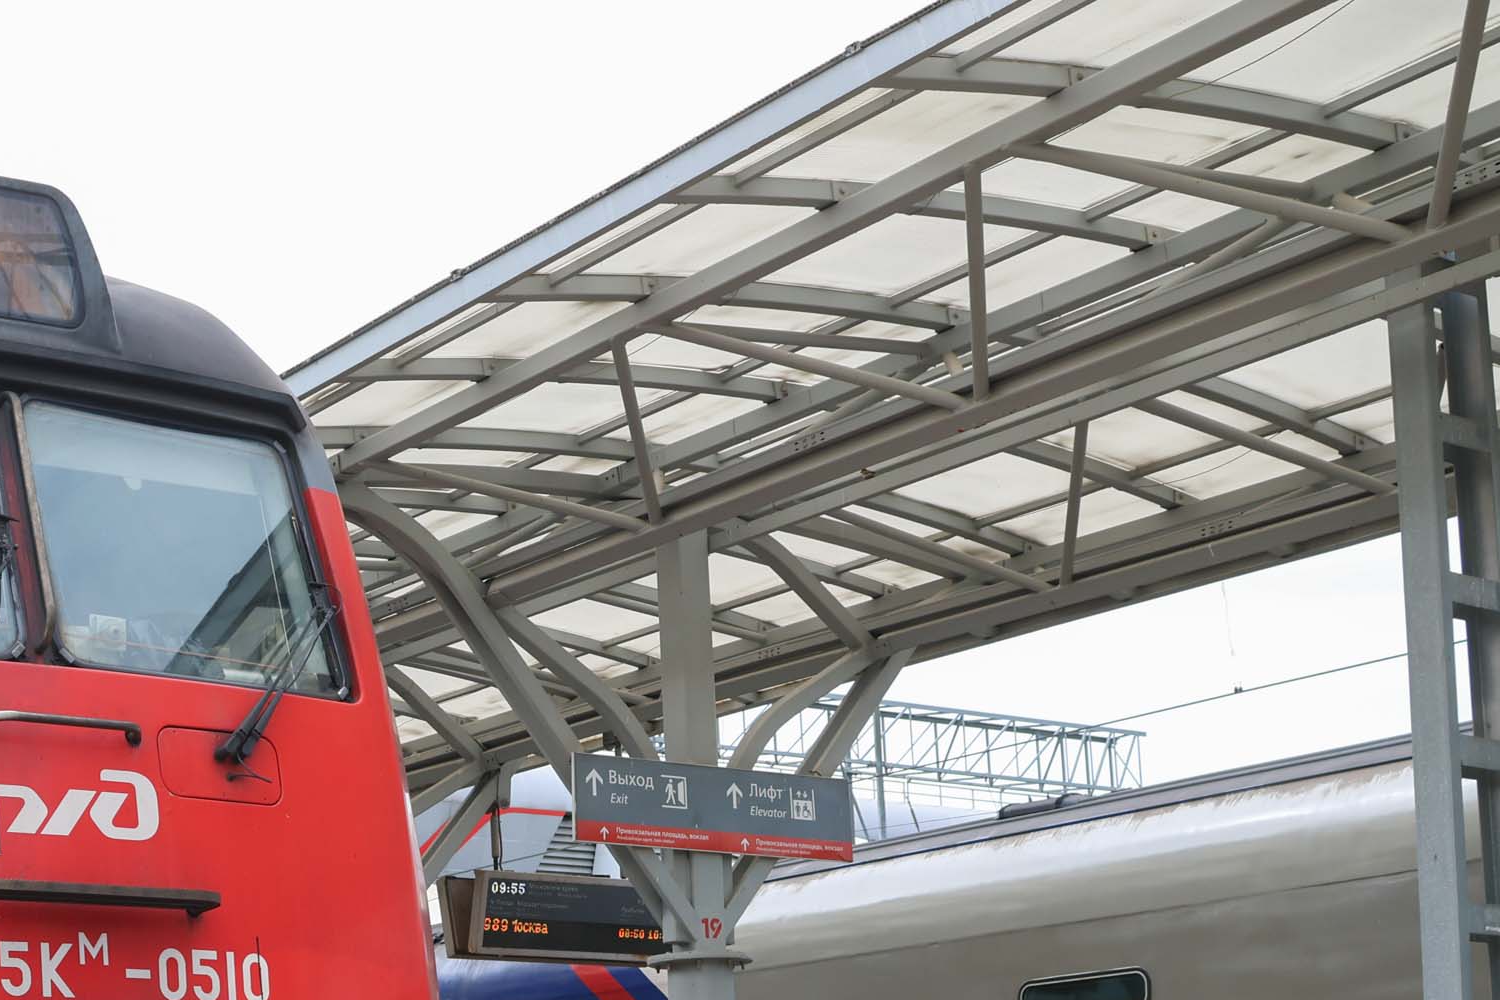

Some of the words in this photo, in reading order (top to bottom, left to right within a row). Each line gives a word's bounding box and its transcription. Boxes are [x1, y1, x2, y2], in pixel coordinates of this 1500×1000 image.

[608, 769, 655, 791] Выход
[610, 792, 629, 806] Exit
[748, 783, 784, 801] Лифт
[749, 805, 787, 820] Elevator
[491, 881, 526, 896] 09:55
[700, 917, 723, 939] 19
